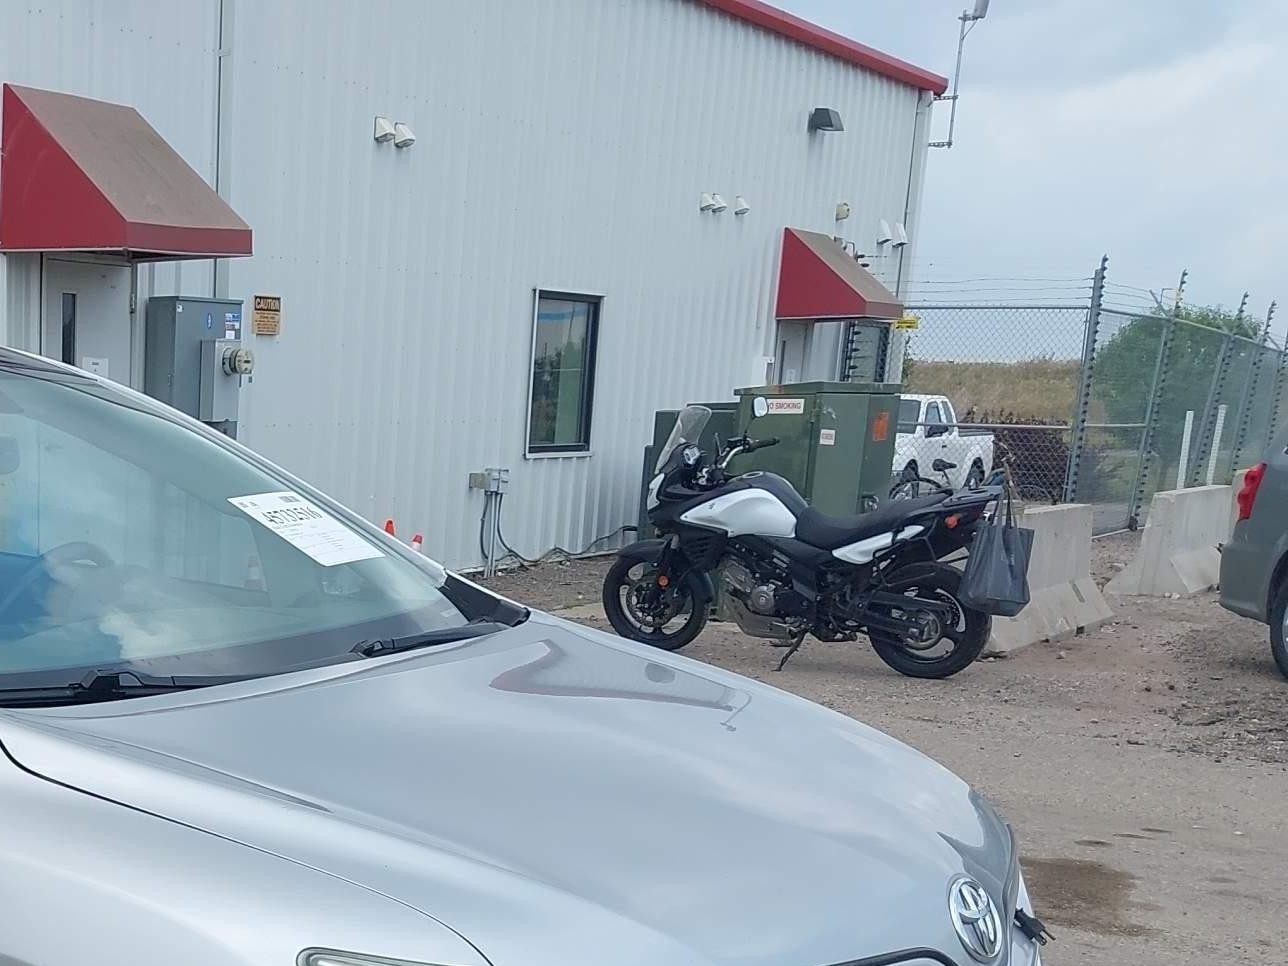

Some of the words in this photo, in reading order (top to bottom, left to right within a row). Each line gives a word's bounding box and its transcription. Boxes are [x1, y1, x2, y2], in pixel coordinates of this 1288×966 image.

[255, 297, 280, 311] CAUTION
[775, 402, 801, 410] SMOKING
[262, 504, 323, 525] 45732516
